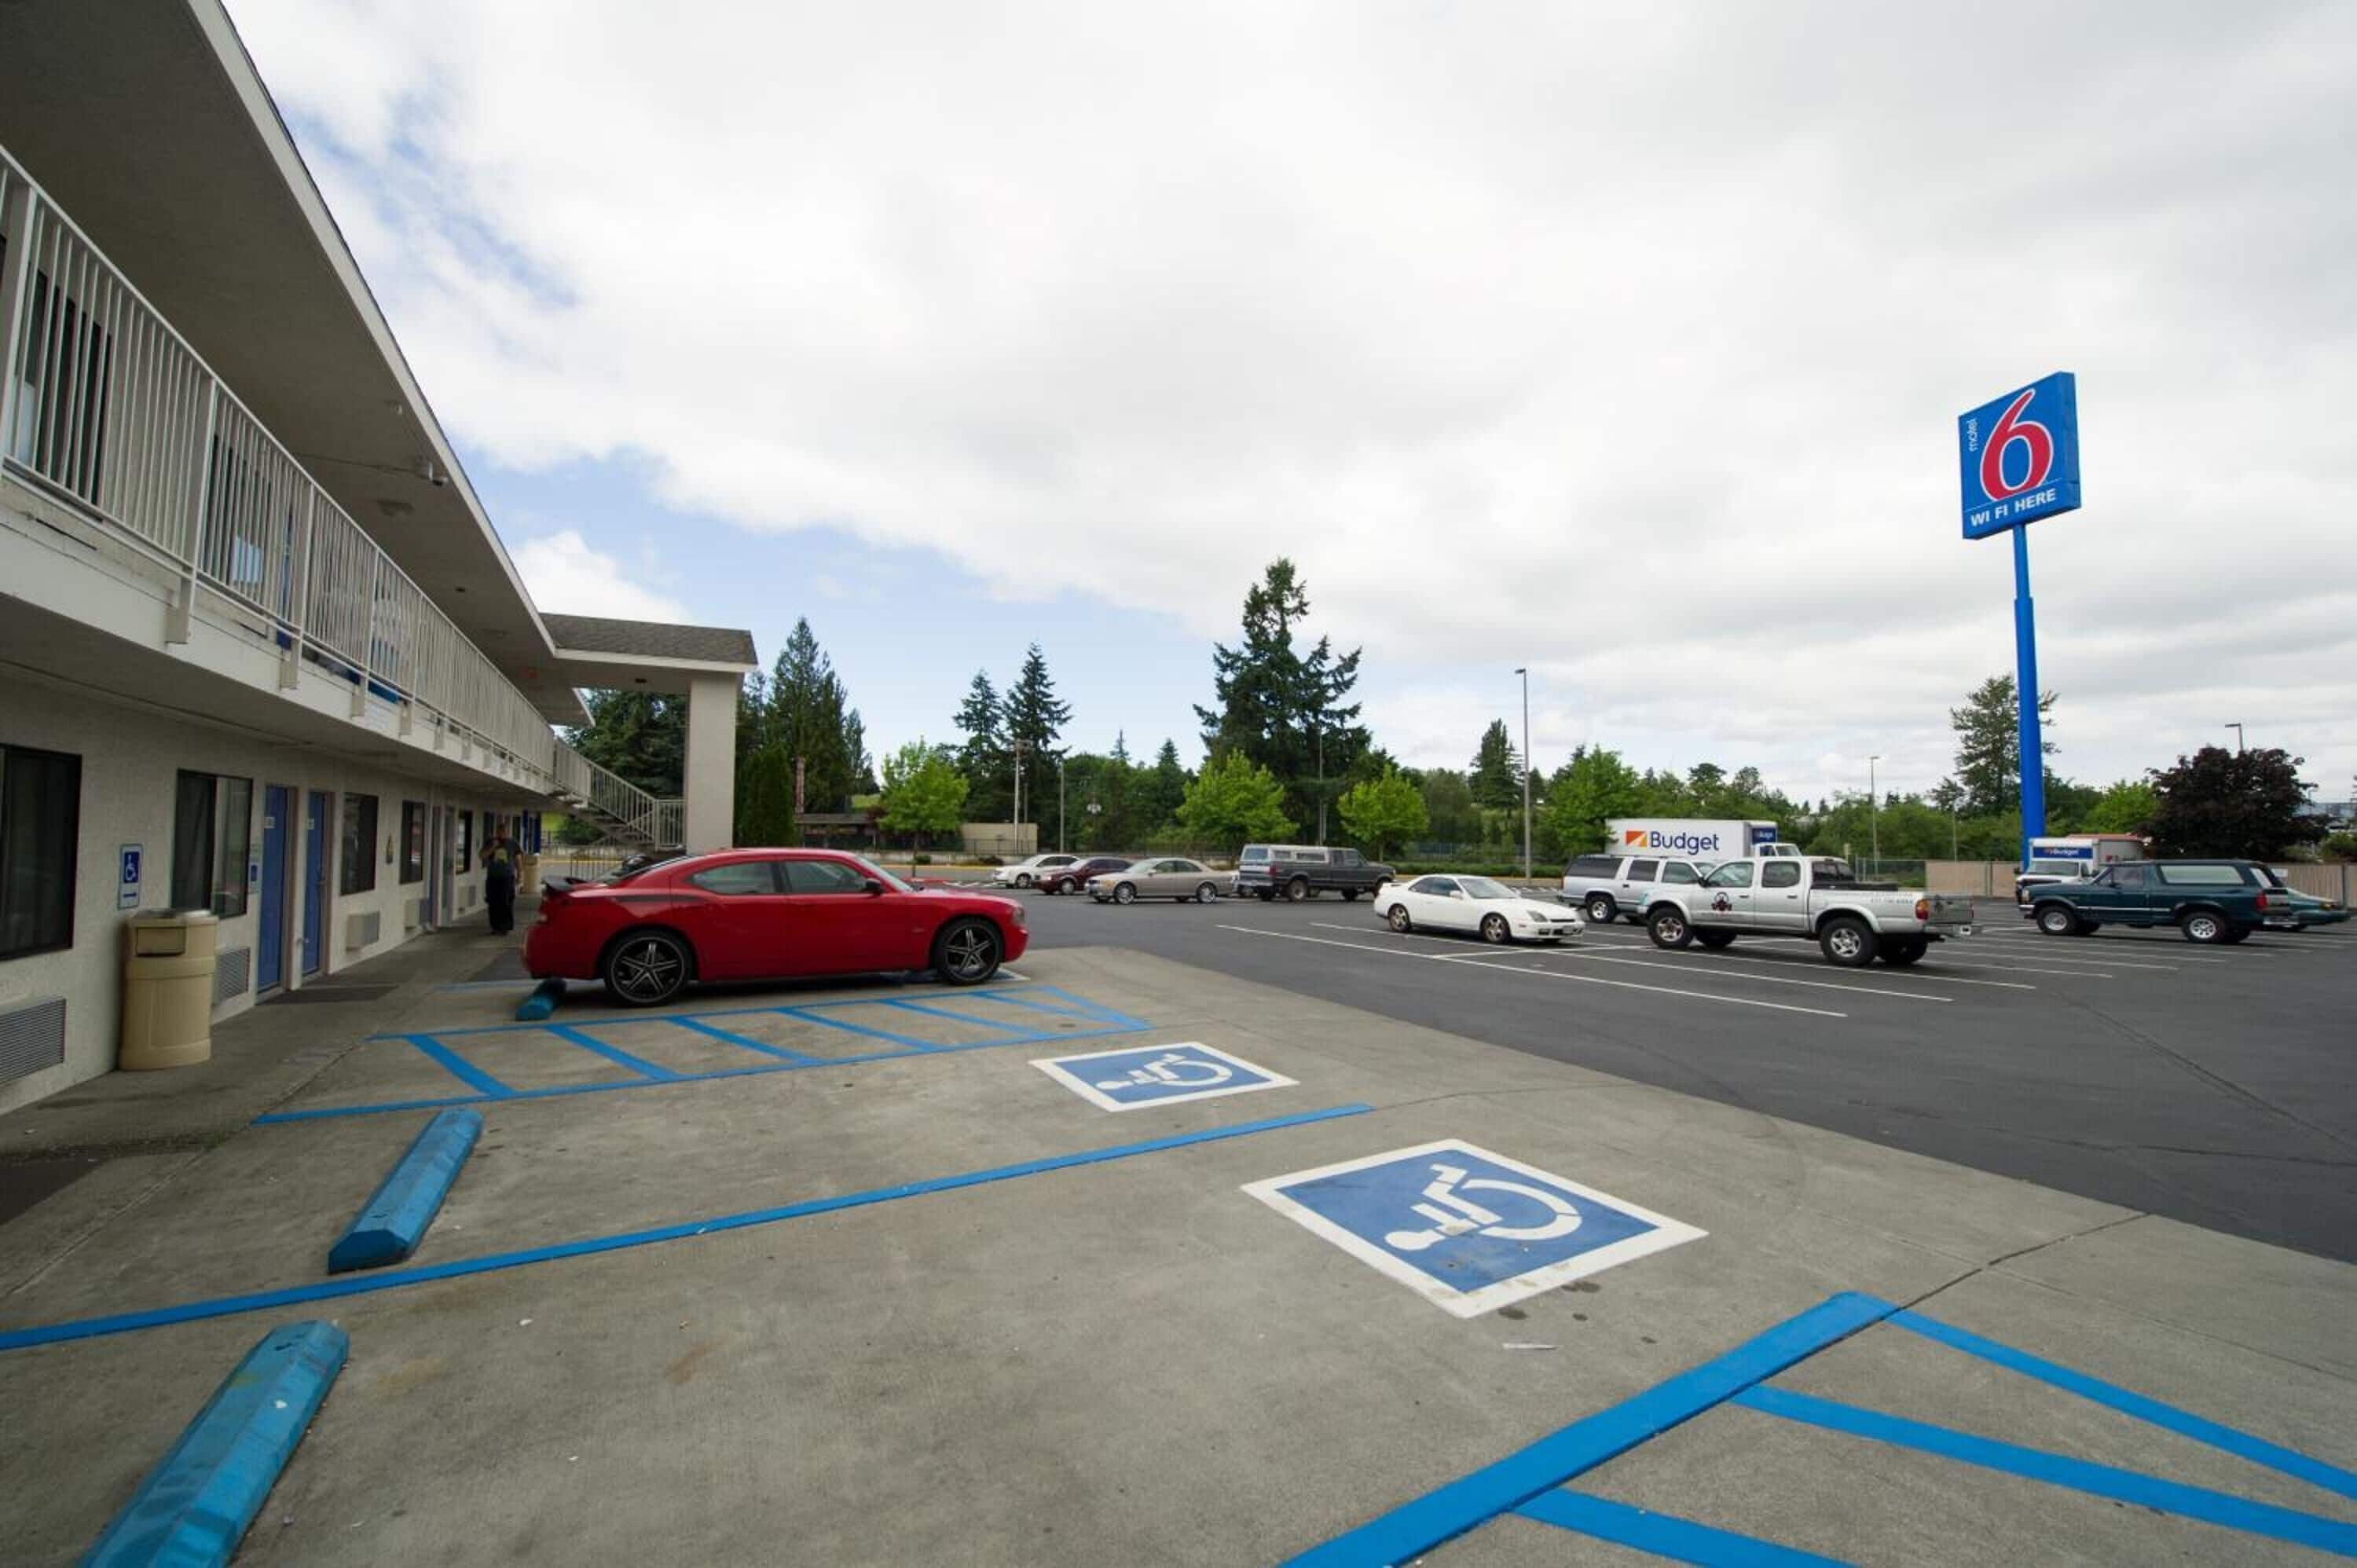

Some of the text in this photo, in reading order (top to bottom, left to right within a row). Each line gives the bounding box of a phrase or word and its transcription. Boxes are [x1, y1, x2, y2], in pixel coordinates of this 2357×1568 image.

[1967, 417, 1978, 452] motel
[1980, 388, 2054, 501] 6
[1970, 489, 2056, 527] WI FI HERE
[1651, 831, 1719, 855] Budget
